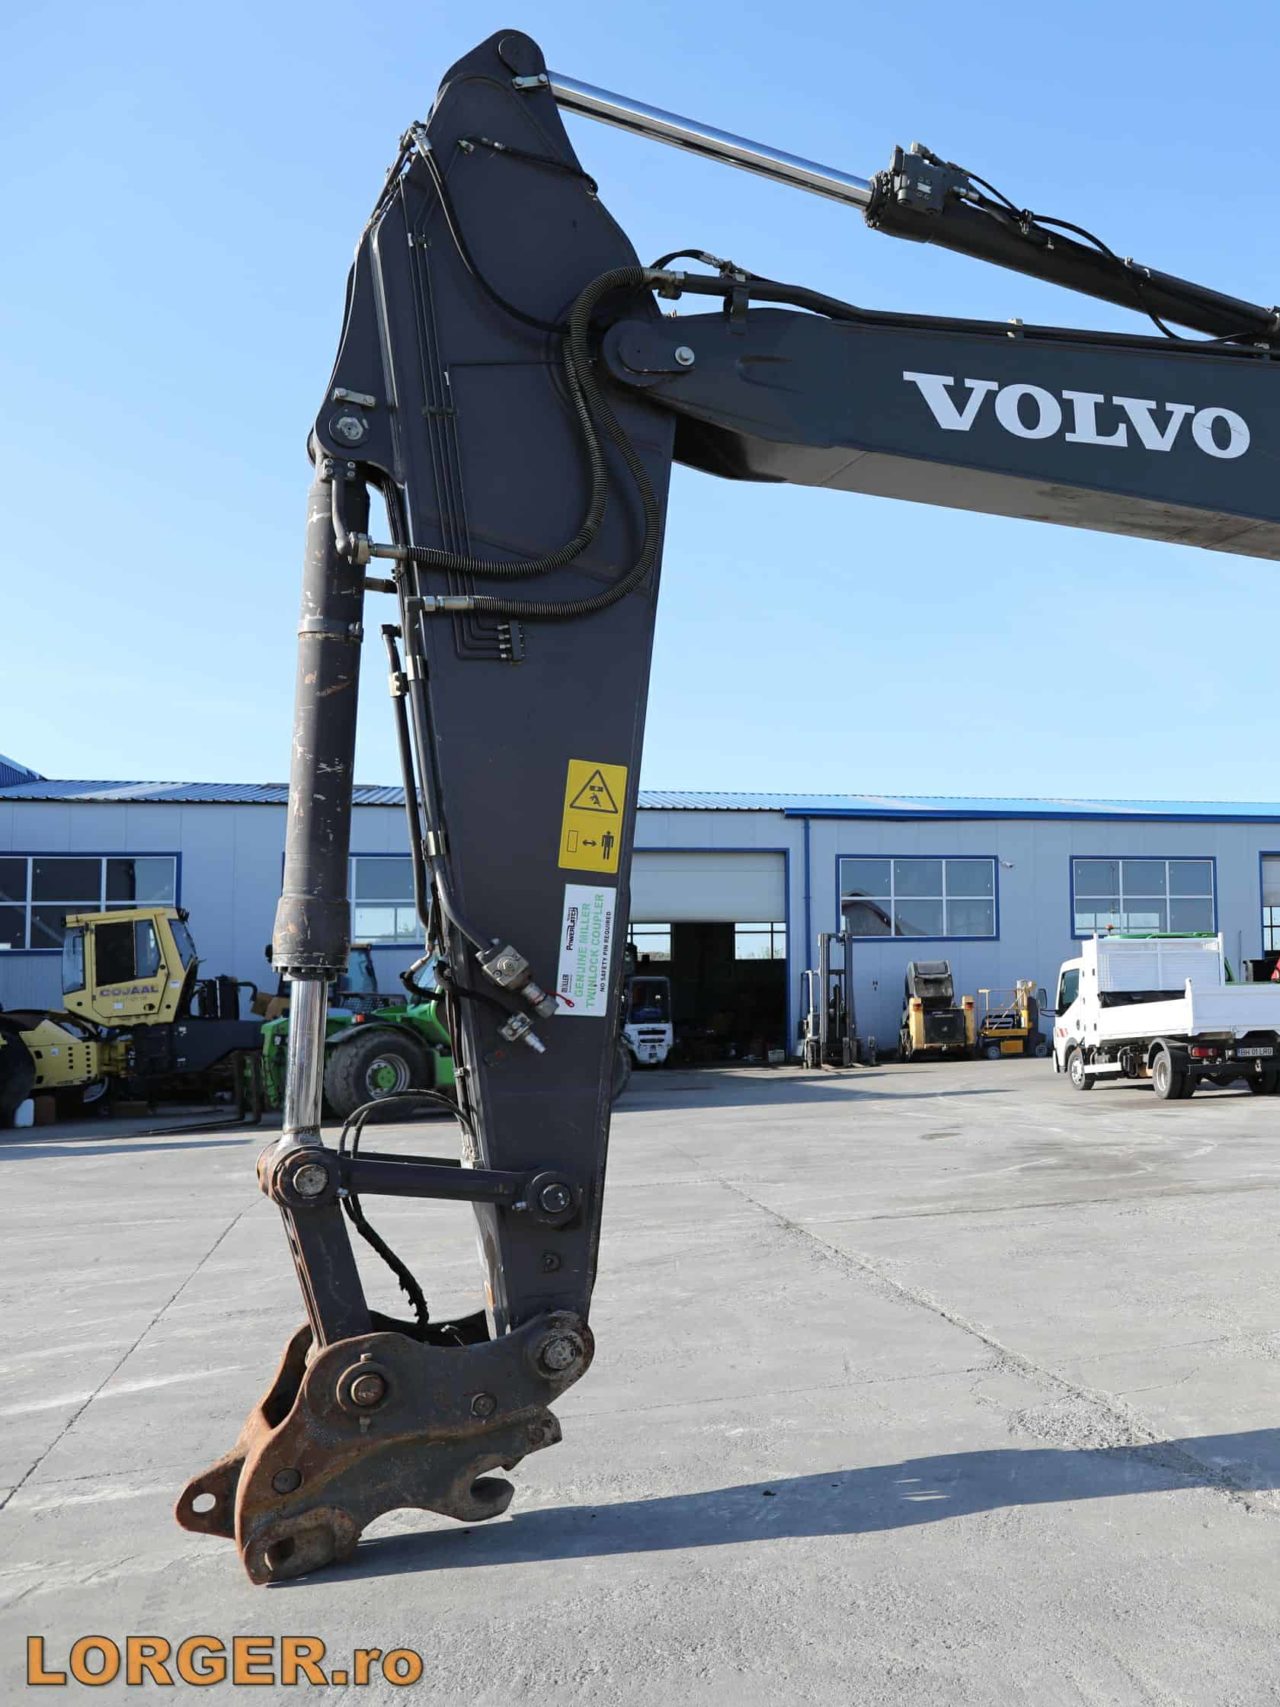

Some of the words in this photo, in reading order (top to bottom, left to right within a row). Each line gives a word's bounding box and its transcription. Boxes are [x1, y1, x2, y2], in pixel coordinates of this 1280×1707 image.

[903, 370, 1251, 459] VOLVO
[579, 903, 591, 944] MILLER
[591, 893, 605, 946] COUPLER
[603, 911, 612, 943] REQUIRED
[575, 947, 587, 997] GENUINE
[585, 949, 600, 1008] TWINLOCK
[600, 957, 608, 981] SAFETY
[600, 982, 606, 993] NO
